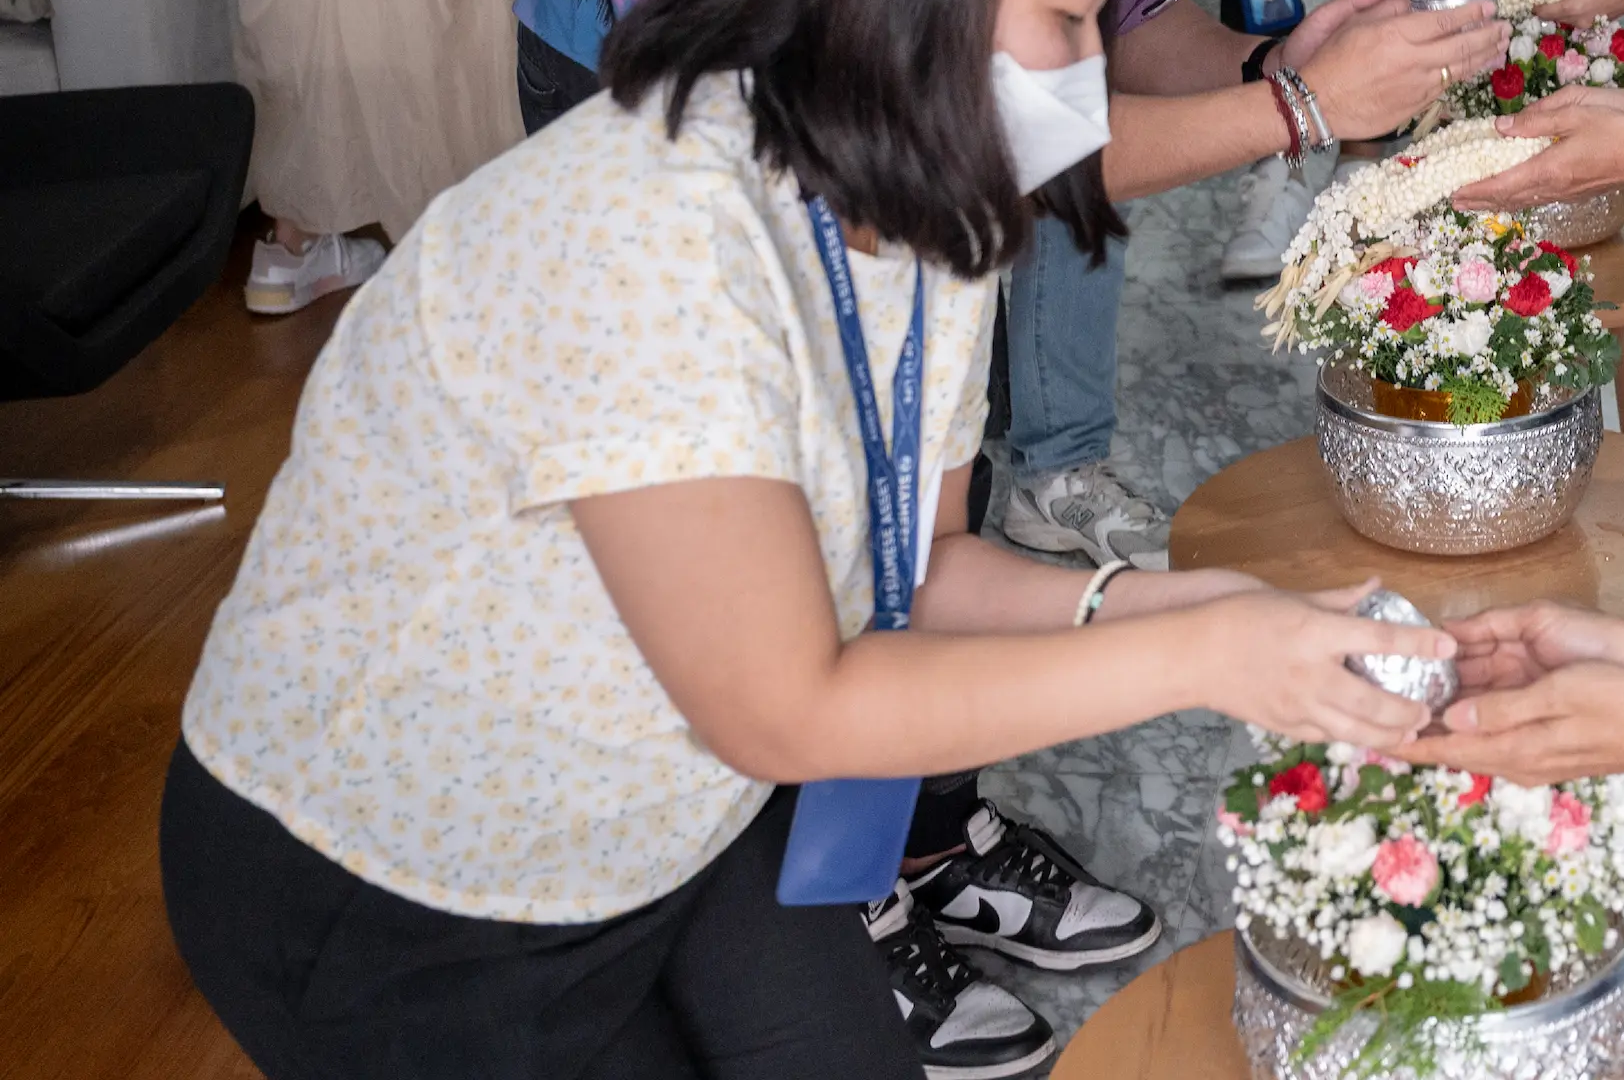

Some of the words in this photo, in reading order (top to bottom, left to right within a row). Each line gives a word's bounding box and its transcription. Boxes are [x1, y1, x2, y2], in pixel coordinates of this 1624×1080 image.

[822, 224, 852, 298] SIAMESE
[876, 476, 893, 524] ASSET
[881, 526, 900, 592] SIAMESE
